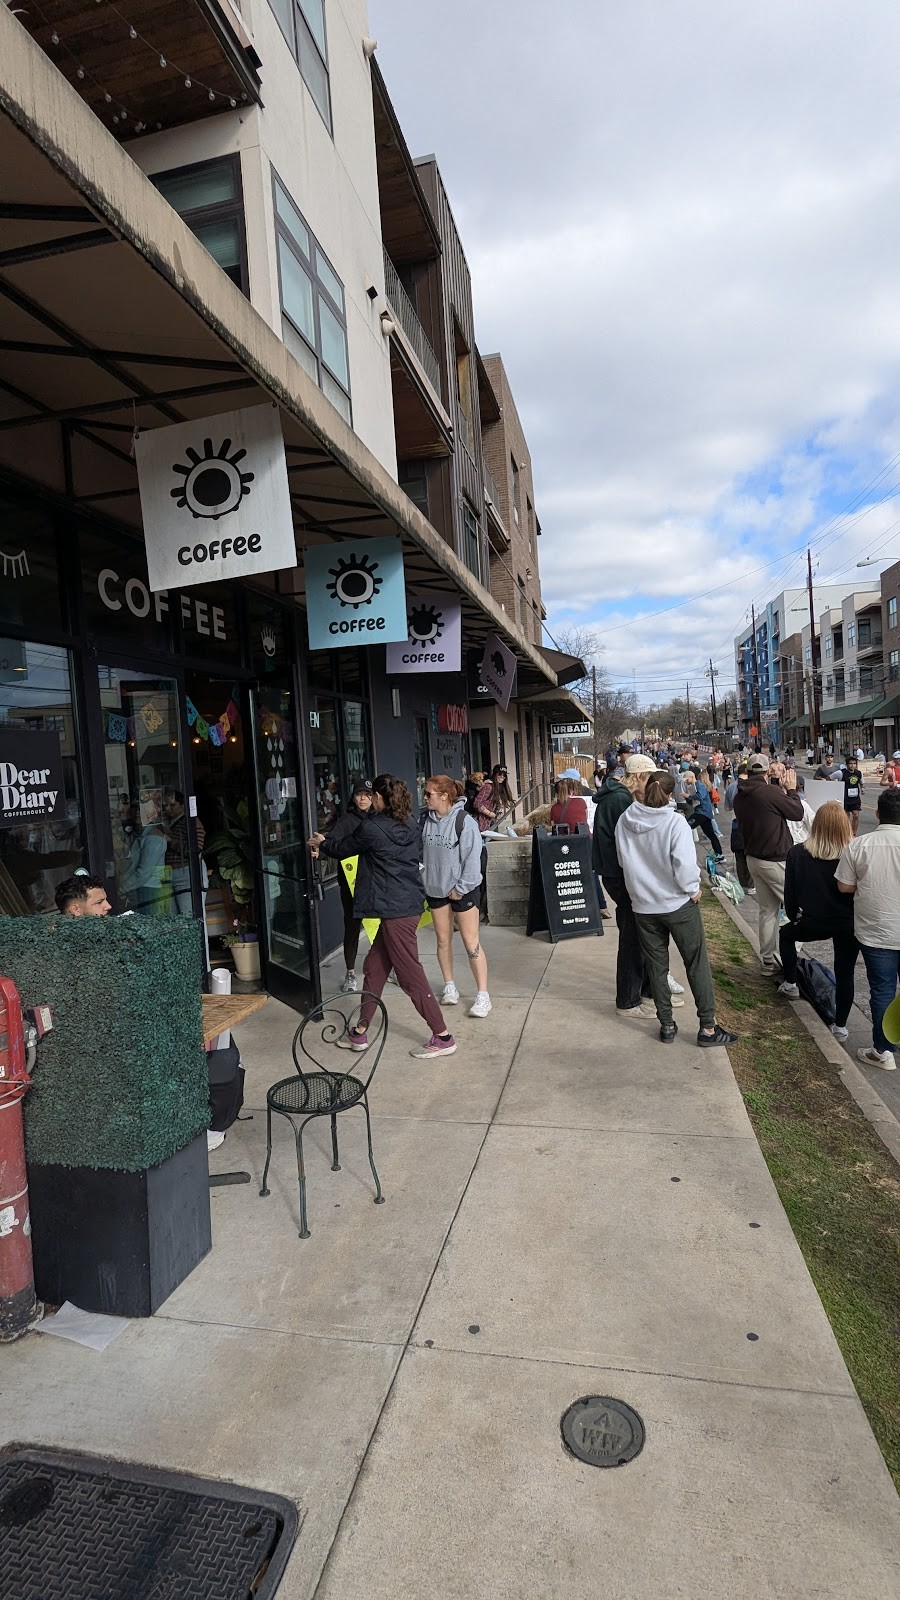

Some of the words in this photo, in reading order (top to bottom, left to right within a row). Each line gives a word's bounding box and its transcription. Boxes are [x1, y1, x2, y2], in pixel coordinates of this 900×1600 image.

[97, 568, 227, 640] COFFEE
[553, 724, 588, 733] URBAN
[0, 762, 51, 786] Dear
[0, 786, 59, 813] Diary
[3, 808, 46, 818] COFFEEHOUSE
[558, 887, 583, 896] LIBRARY
[99, 1487, 160, 1512] METER
